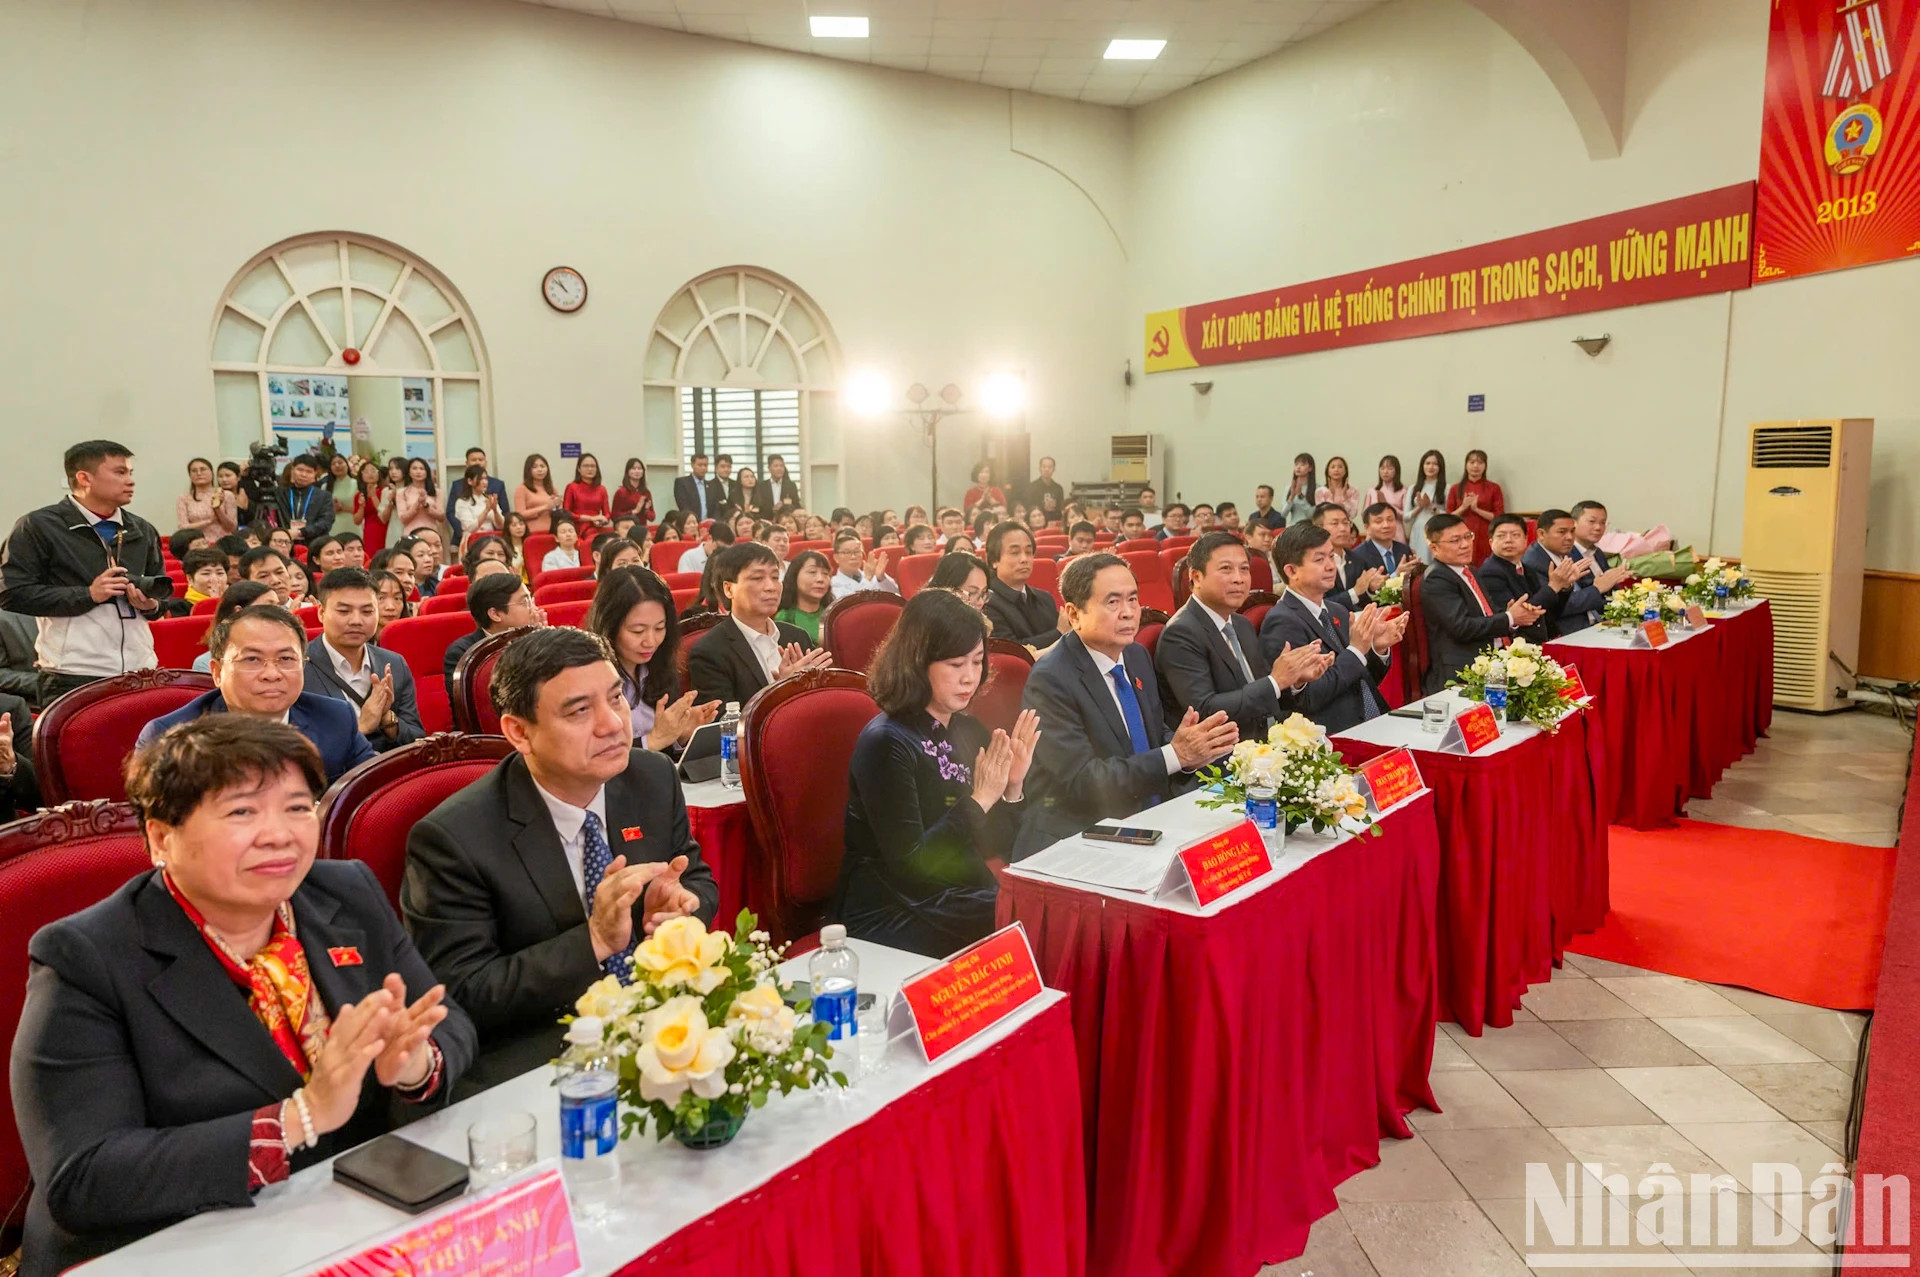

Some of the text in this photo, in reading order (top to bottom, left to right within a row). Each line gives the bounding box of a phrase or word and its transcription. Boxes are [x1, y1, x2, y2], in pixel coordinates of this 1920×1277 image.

[1816, 191, 1877, 225] 2013
[1202, 212, 1749, 351] XÂY DỰNG ĐẢNG VÀ HỆ THỐNG CHÍNH TRỊ TRONG SẠCH, VỮNG MẠNH
[989, 951, 1014, 971] VINH
[495, 1207, 541, 1243] ANH
